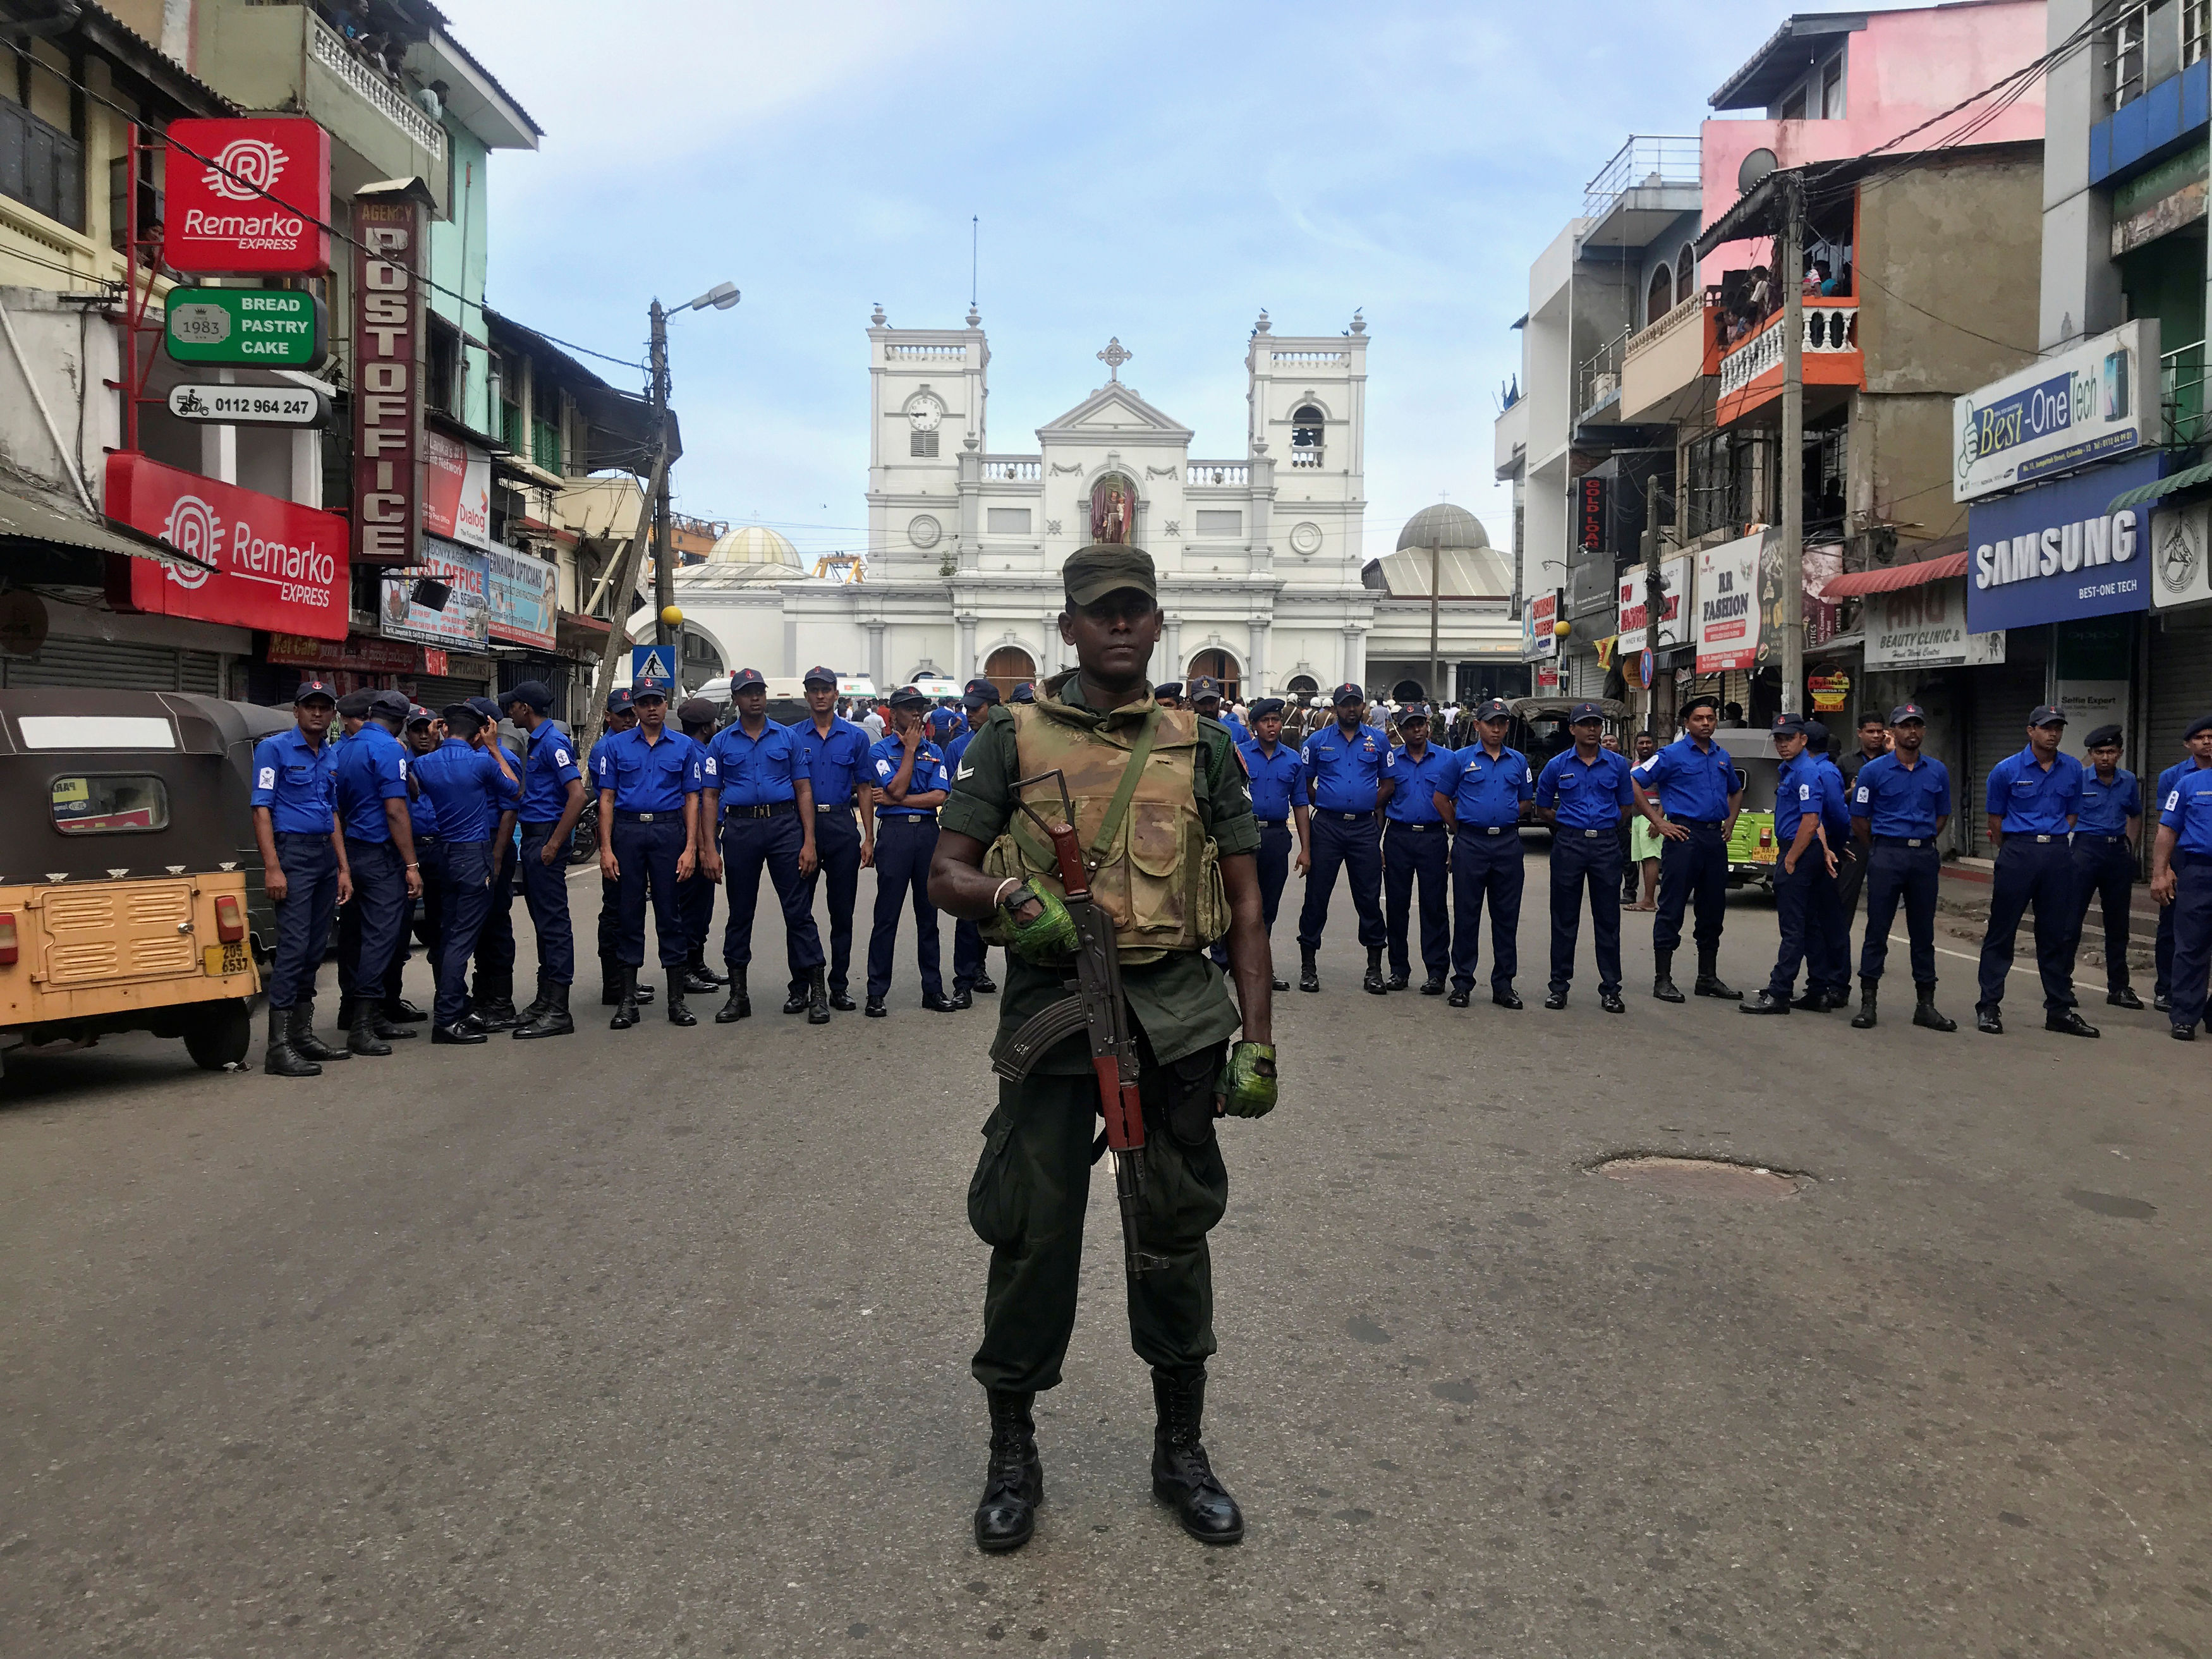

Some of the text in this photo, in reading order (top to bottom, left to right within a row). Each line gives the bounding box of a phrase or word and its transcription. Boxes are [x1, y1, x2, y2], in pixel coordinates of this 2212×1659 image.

[185, 209, 303, 236] Remarko
[362, 204, 411, 221] AGENCY
[238, 238, 298, 250] EXPRESS
[241, 298, 300, 312] BREAD
[183, 320, 219, 335] 1983
[241, 319, 308, 334] PASTRY
[241, 341, 289, 355] CAKE
[216, 398, 308, 414] 0112 964 247
[2070, 367, 2097, 423] Tech
[430, 434, 453, 458] Lanka's
[439, 456, 462, 477] Network
[460, 503, 485, 533] Dialog
[1585, 480, 1600, 548] GOLD LOAN
[233, 521, 335, 585] Remarko
[422, 542, 474, 566] ARDONYX AGENCY
[1976, 510, 2137, 589] SAMSUNG
[444, 562, 482, 594] OFFICE
[489, 551, 542, 589] ERNANDO OPTICIANS
[1718, 571, 1733, 593] RR
[2079, 579, 2137, 599] BEST-ONE TECH
[281, 582, 330, 607] EXPRESS
[1533, 595, 1556, 619] BOMBAY
[1703, 593, 1749, 623] FASHION
[1880, 628, 1960, 649] BEAUTY CLINIC &
[449, 660, 486, 676] OPTICIANS
[2062, 696, 2116, 705] Selfie Expert
[222, 957, 248, 973] 6537
